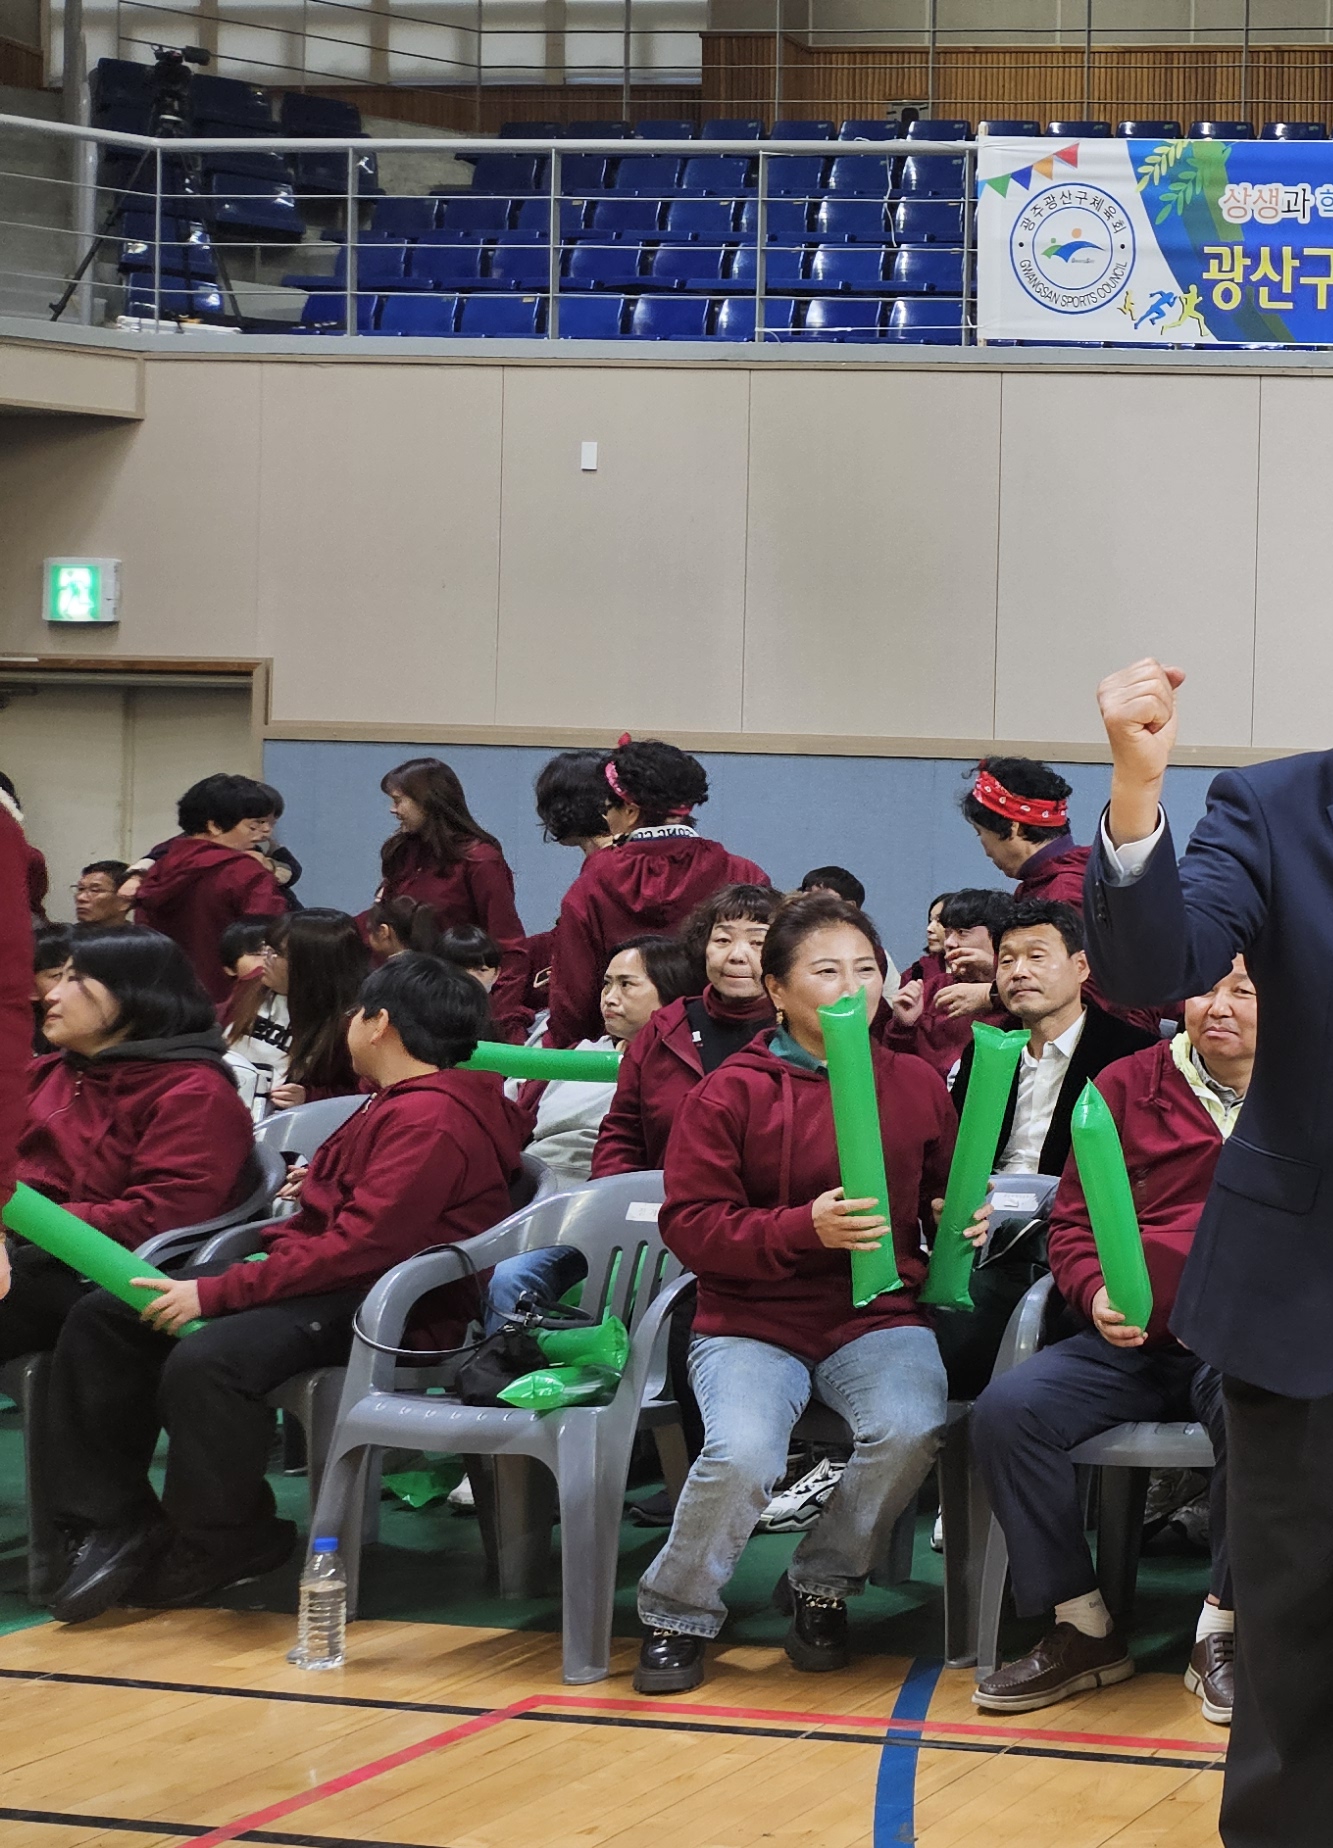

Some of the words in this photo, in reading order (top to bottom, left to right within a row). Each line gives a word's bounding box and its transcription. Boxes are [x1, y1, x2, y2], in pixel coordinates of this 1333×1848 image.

[1020, 190, 1127, 234] 광주광산구체육회
[1223, 186, 1311, 221] 상생과
[1020, 259, 1060, 304] GWANGSAN
[1061, 293, 1098, 308] SPORTS
[1096, 260, 1128, 298] COUNCIL
